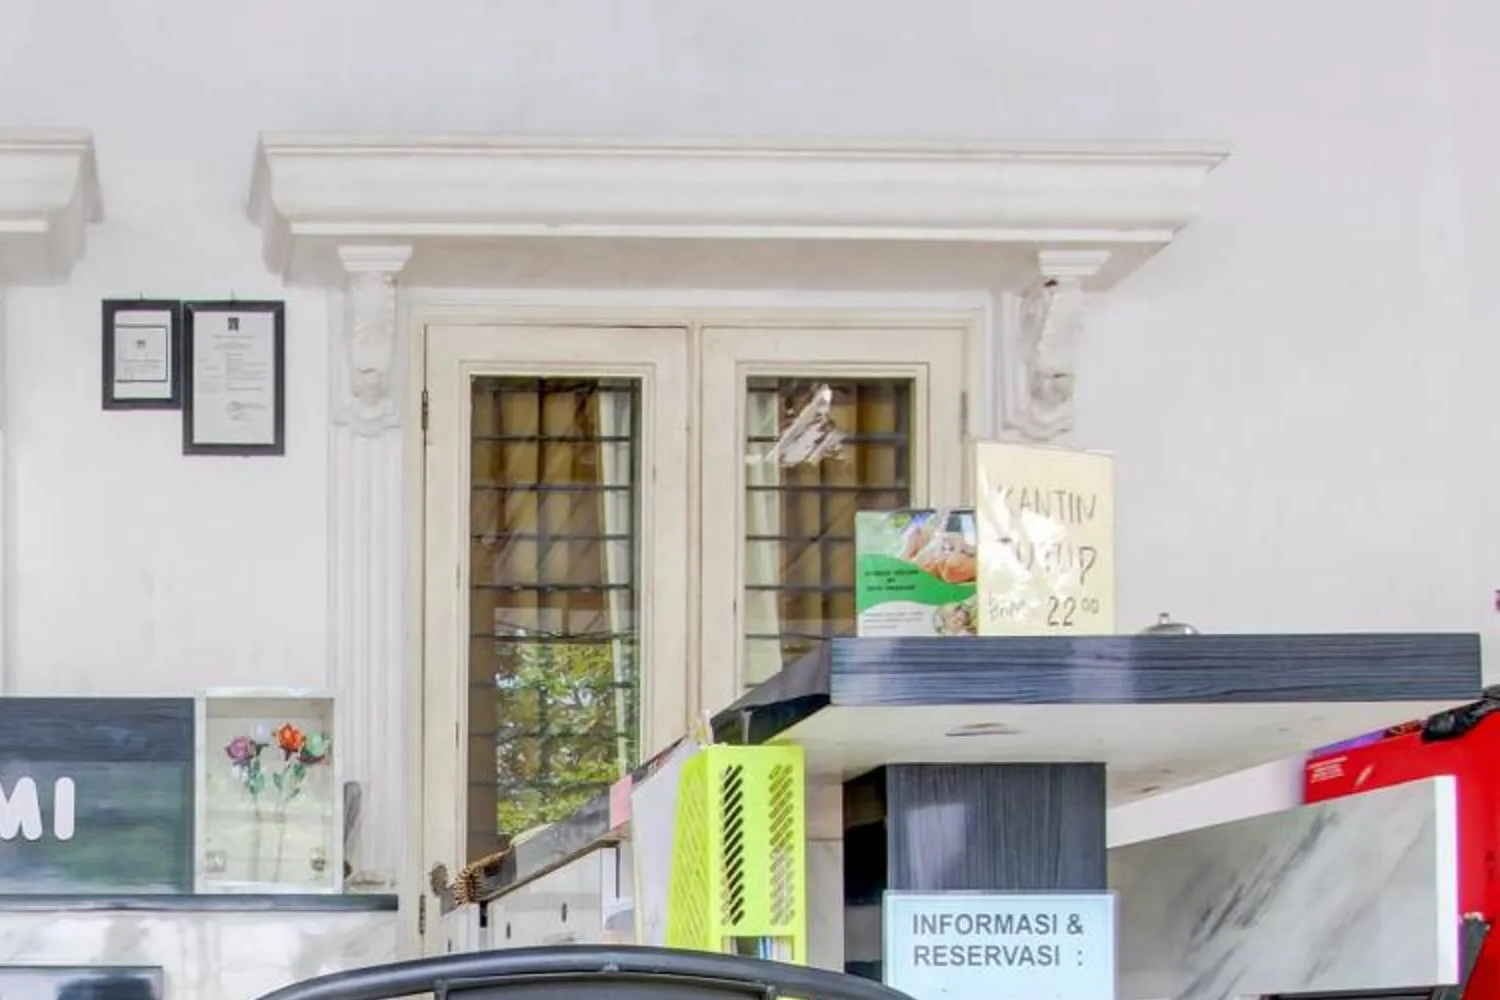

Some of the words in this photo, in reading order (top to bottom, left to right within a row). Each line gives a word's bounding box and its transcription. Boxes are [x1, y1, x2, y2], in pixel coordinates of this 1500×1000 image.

[913, 913, 1058, 936] INFORMASI
[1066, 913, 1085, 936] &
[913, 945, 1061, 967] RESERVASI
